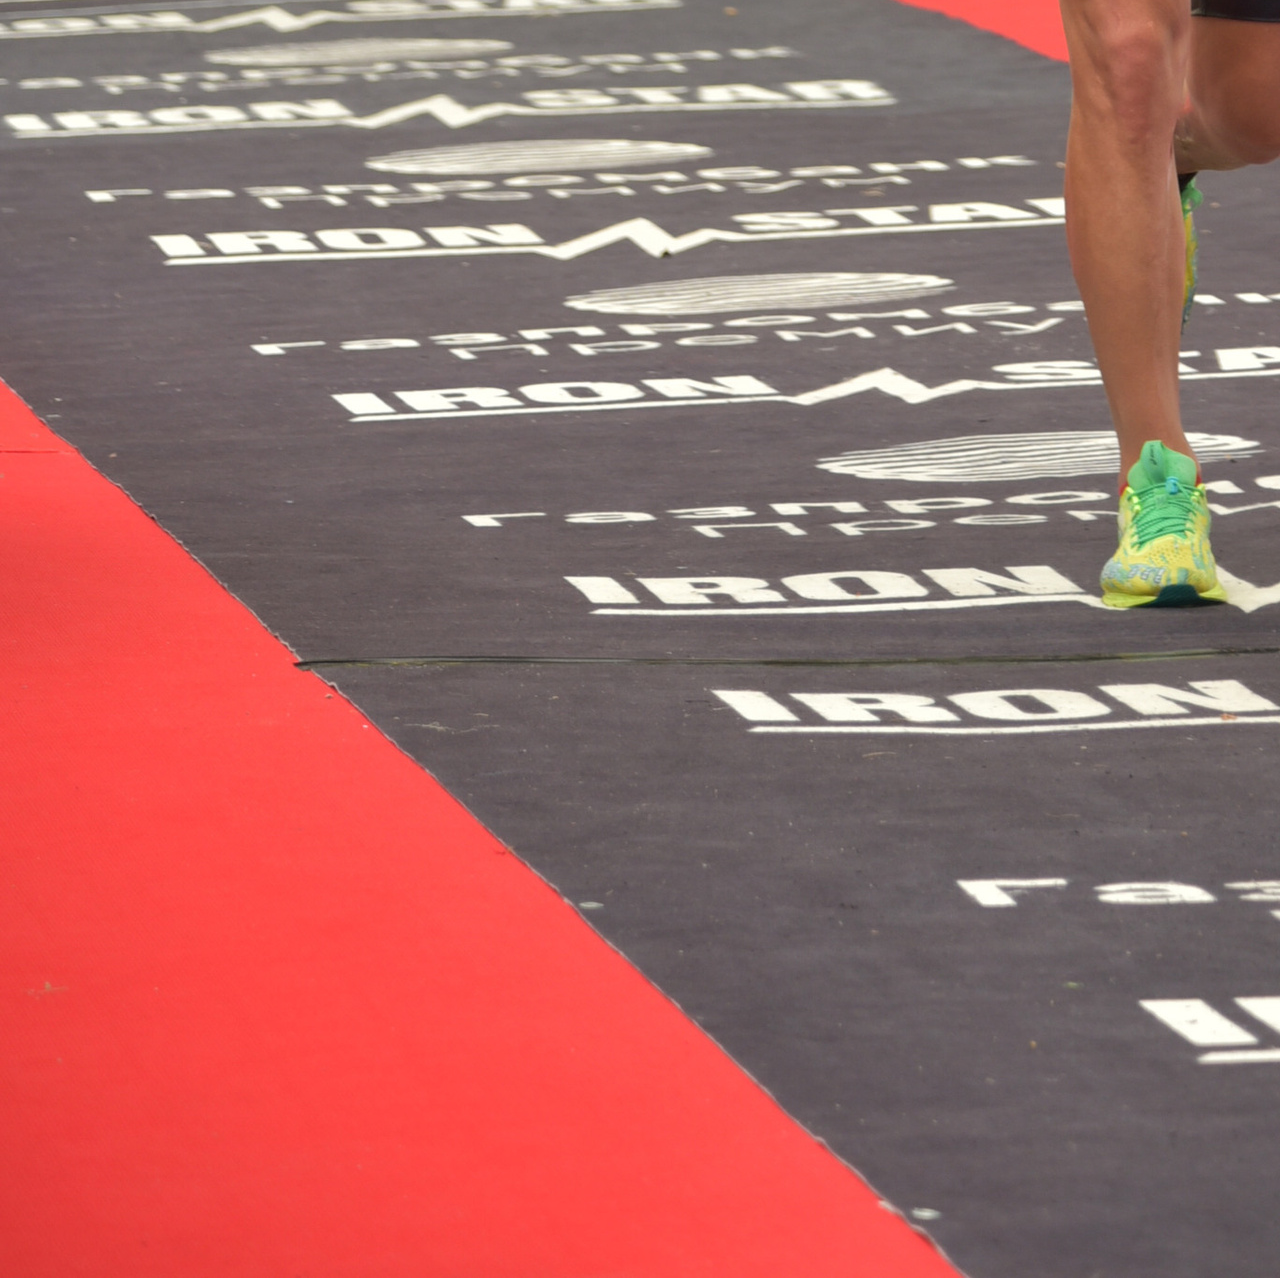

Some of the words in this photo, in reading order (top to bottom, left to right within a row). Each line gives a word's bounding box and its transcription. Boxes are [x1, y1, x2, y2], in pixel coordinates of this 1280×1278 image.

[3, 98, 353, 134] IRON
[520, 79, 890, 111] STAR
[150, 222, 543, 258] IRON
[448, 317, 1066, 360] Премиу
[331, 375, 781, 415] IRON
[563, 565, 1085, 605] IRON
